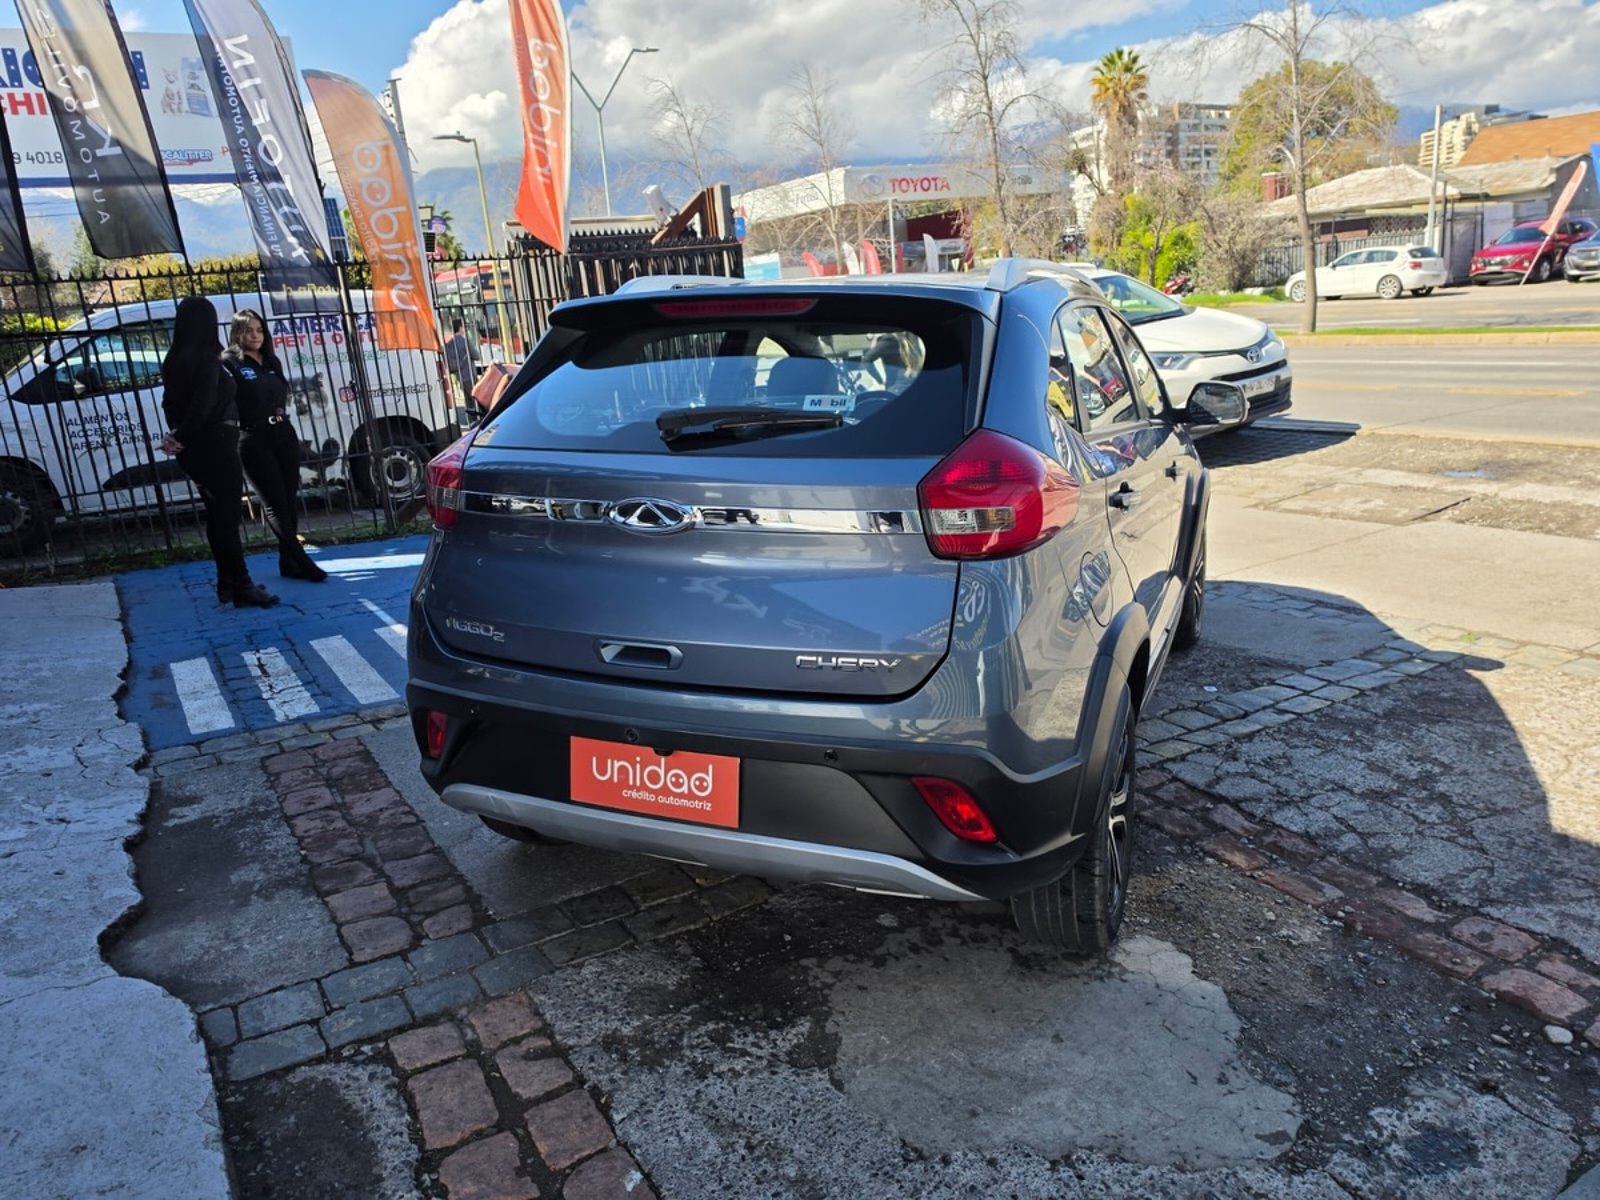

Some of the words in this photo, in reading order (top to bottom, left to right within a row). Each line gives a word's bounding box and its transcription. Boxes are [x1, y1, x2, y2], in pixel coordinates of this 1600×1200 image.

[889, 177, 951, 194] TOYOTA
[272, 335, 306, 349] PET
[796, 655, 902, 672] CHERY
[592, 756, 714, 797] unidad
[622, 787, 656, 803] crédito
[657, 794, 713, 812] automotriz
